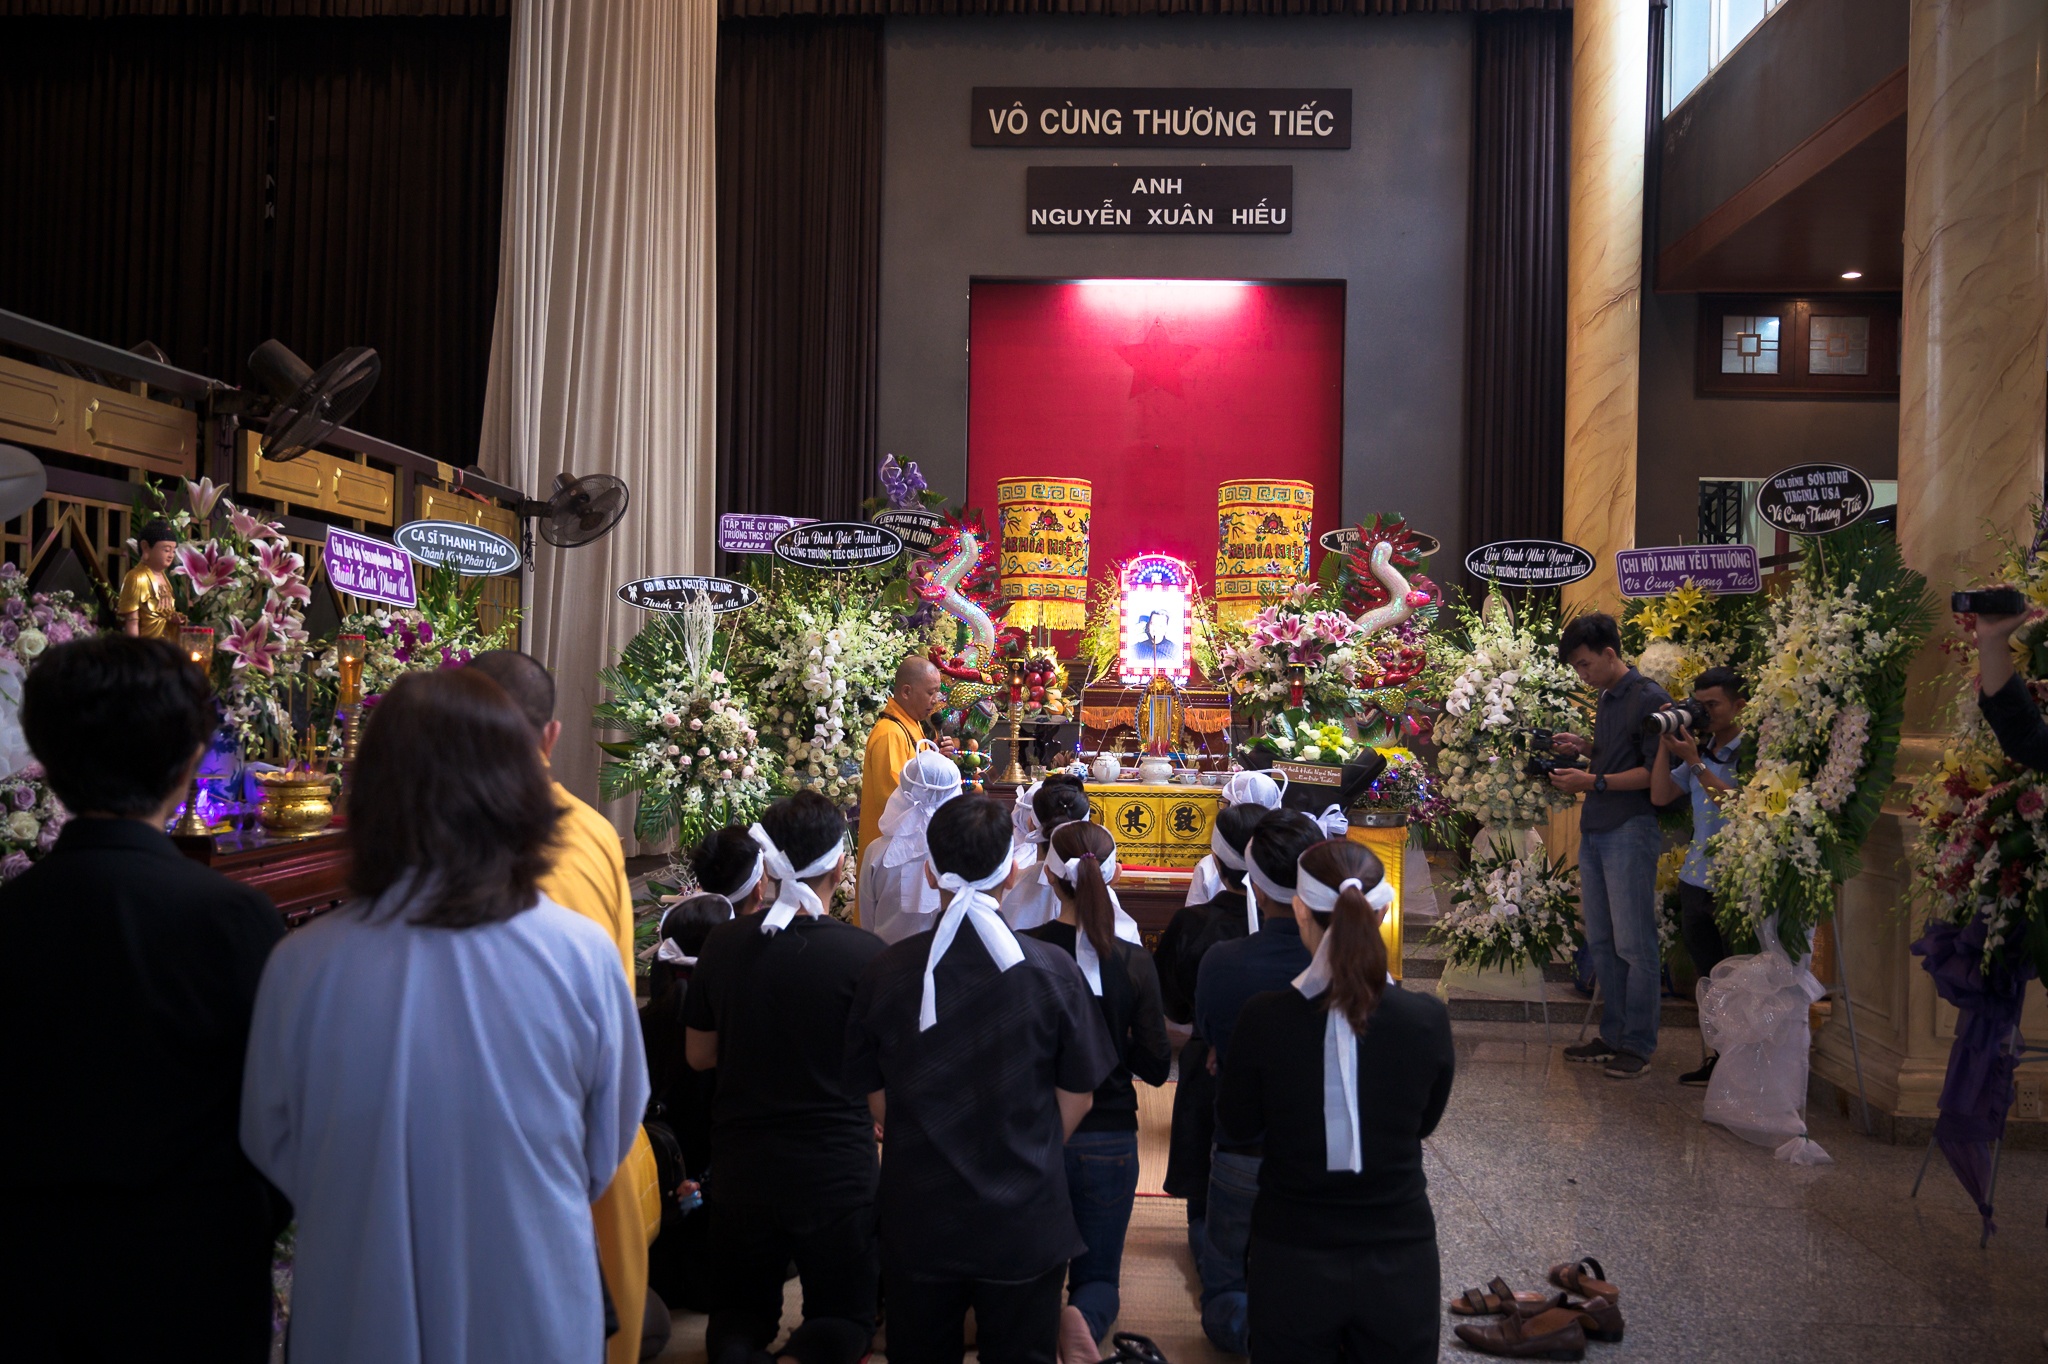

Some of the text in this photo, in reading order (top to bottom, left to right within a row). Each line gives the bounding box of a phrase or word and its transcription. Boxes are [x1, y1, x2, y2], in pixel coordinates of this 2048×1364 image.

[989, 101, 1334, 137] VÔ CÙNG THƯƠNG TIẾC
[1132, 178, 1182, 194] ANH
[1031, 199, 1286, 225] NGUYỄN XUÂN HIẾU
[1774, 478, 1787, 489] GIA
[1783, 486, 1841, 504] VIRGINIA USA
[912, 516, 918, 524] &
[1768, 504, 1782, 522] Vô
[1784, 506, 1806, 530] Cùng
[1841, 494, 1862, 516] Tiếc
[725, 518, 740, 529] TẬP
[757, 522, 766, 530] GV
[769, 522, 788, 532] CMHS
[411, 529, 507, 556] CA SĨ THANH THẢO
[748, 531, 764, 540] THCS
[794, 530, 881, 546] Gia Đình Bác Thành
[911, 529, 932, 546] KÍNH
[724, 541, 766, 549] KÍNH
[780, 544, 790, 556] VÔ
[790, 546, 806, 558] CÙNG
[807, 548, 832, 560] THƯƠNG
[832, 545, 846, 560] TIẾC
[864, 546, 881, 558] XUÂN
[882, 541, 896, 556] HIẾU
[420, 546, 444, 560] Thành
[464, 554, 484, 568] Phân
[486, 556, 497, 569] Ưu
[1484, 546, 1500, 564] Gia
[1502, 547, 1524, 562] Đình
[1525, 548, 1545, 562] Nhà
[1622, 550, 1752, 575] CHI HỘI XANH YÊU THƯƠNG
[1471, 560, 1479, 572] VÔ
[1496, 564, 1518, 578] THƯƠNG
[1518, 562, 1532, 578] TIẾC
[1532, 567, 1545, 578] CON
[1571, 561, 1586, 576] HIẾU
[644, 582, 654, 592] GĐ
[667, 579, 682, 590] SAX
[682, 577, 708, 590] NGUYỄN
[710, 581, 732, 594] KHANG
[1624, 577, 1640, 590] Vô
[1644, 576, 1676, 592] Cùng
[1728, 572, 1755, 586] Tiếc
